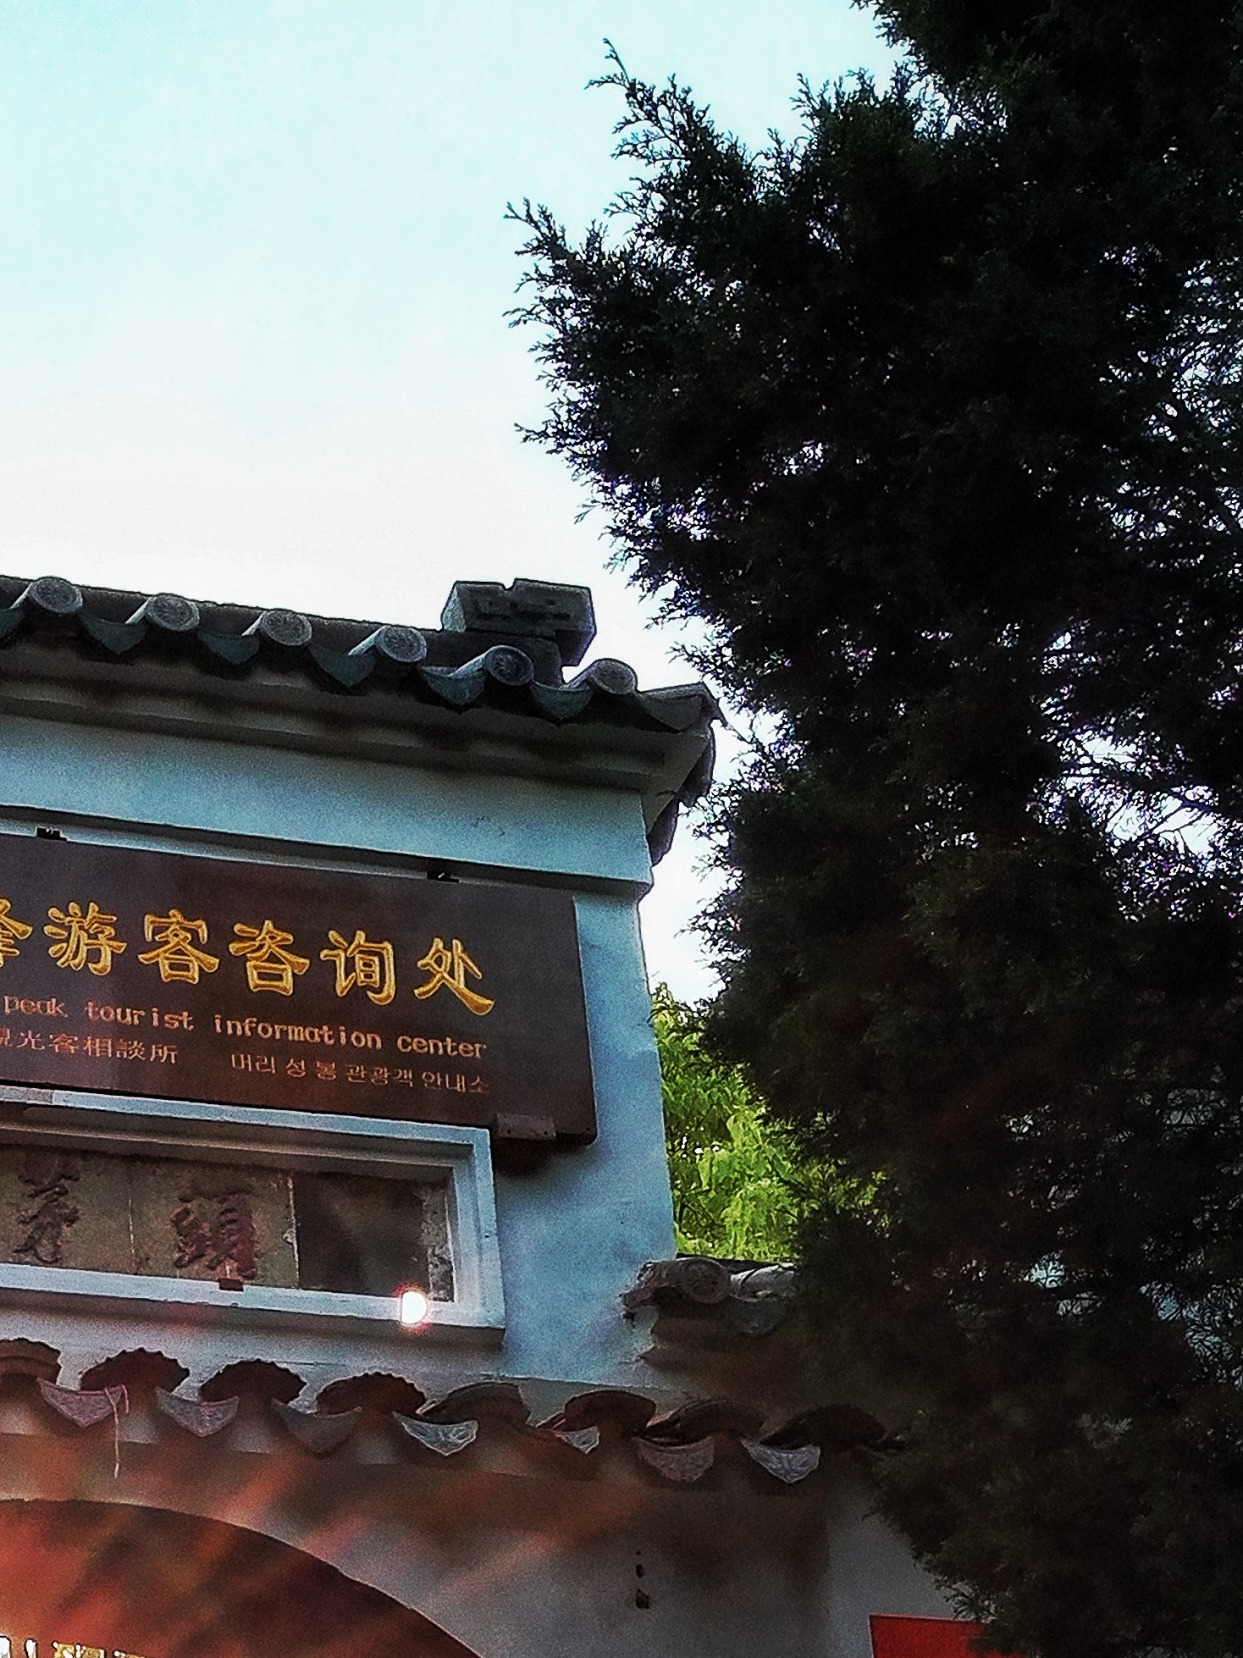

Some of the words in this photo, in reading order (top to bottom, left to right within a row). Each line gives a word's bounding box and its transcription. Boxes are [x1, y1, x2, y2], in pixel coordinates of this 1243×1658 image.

[4, 996, 68, 1018] peak
[86, 1000, 194, 1031] tourist
[214, 1013, 382, 1050] information
[397, 1033, 488, 1060] center
